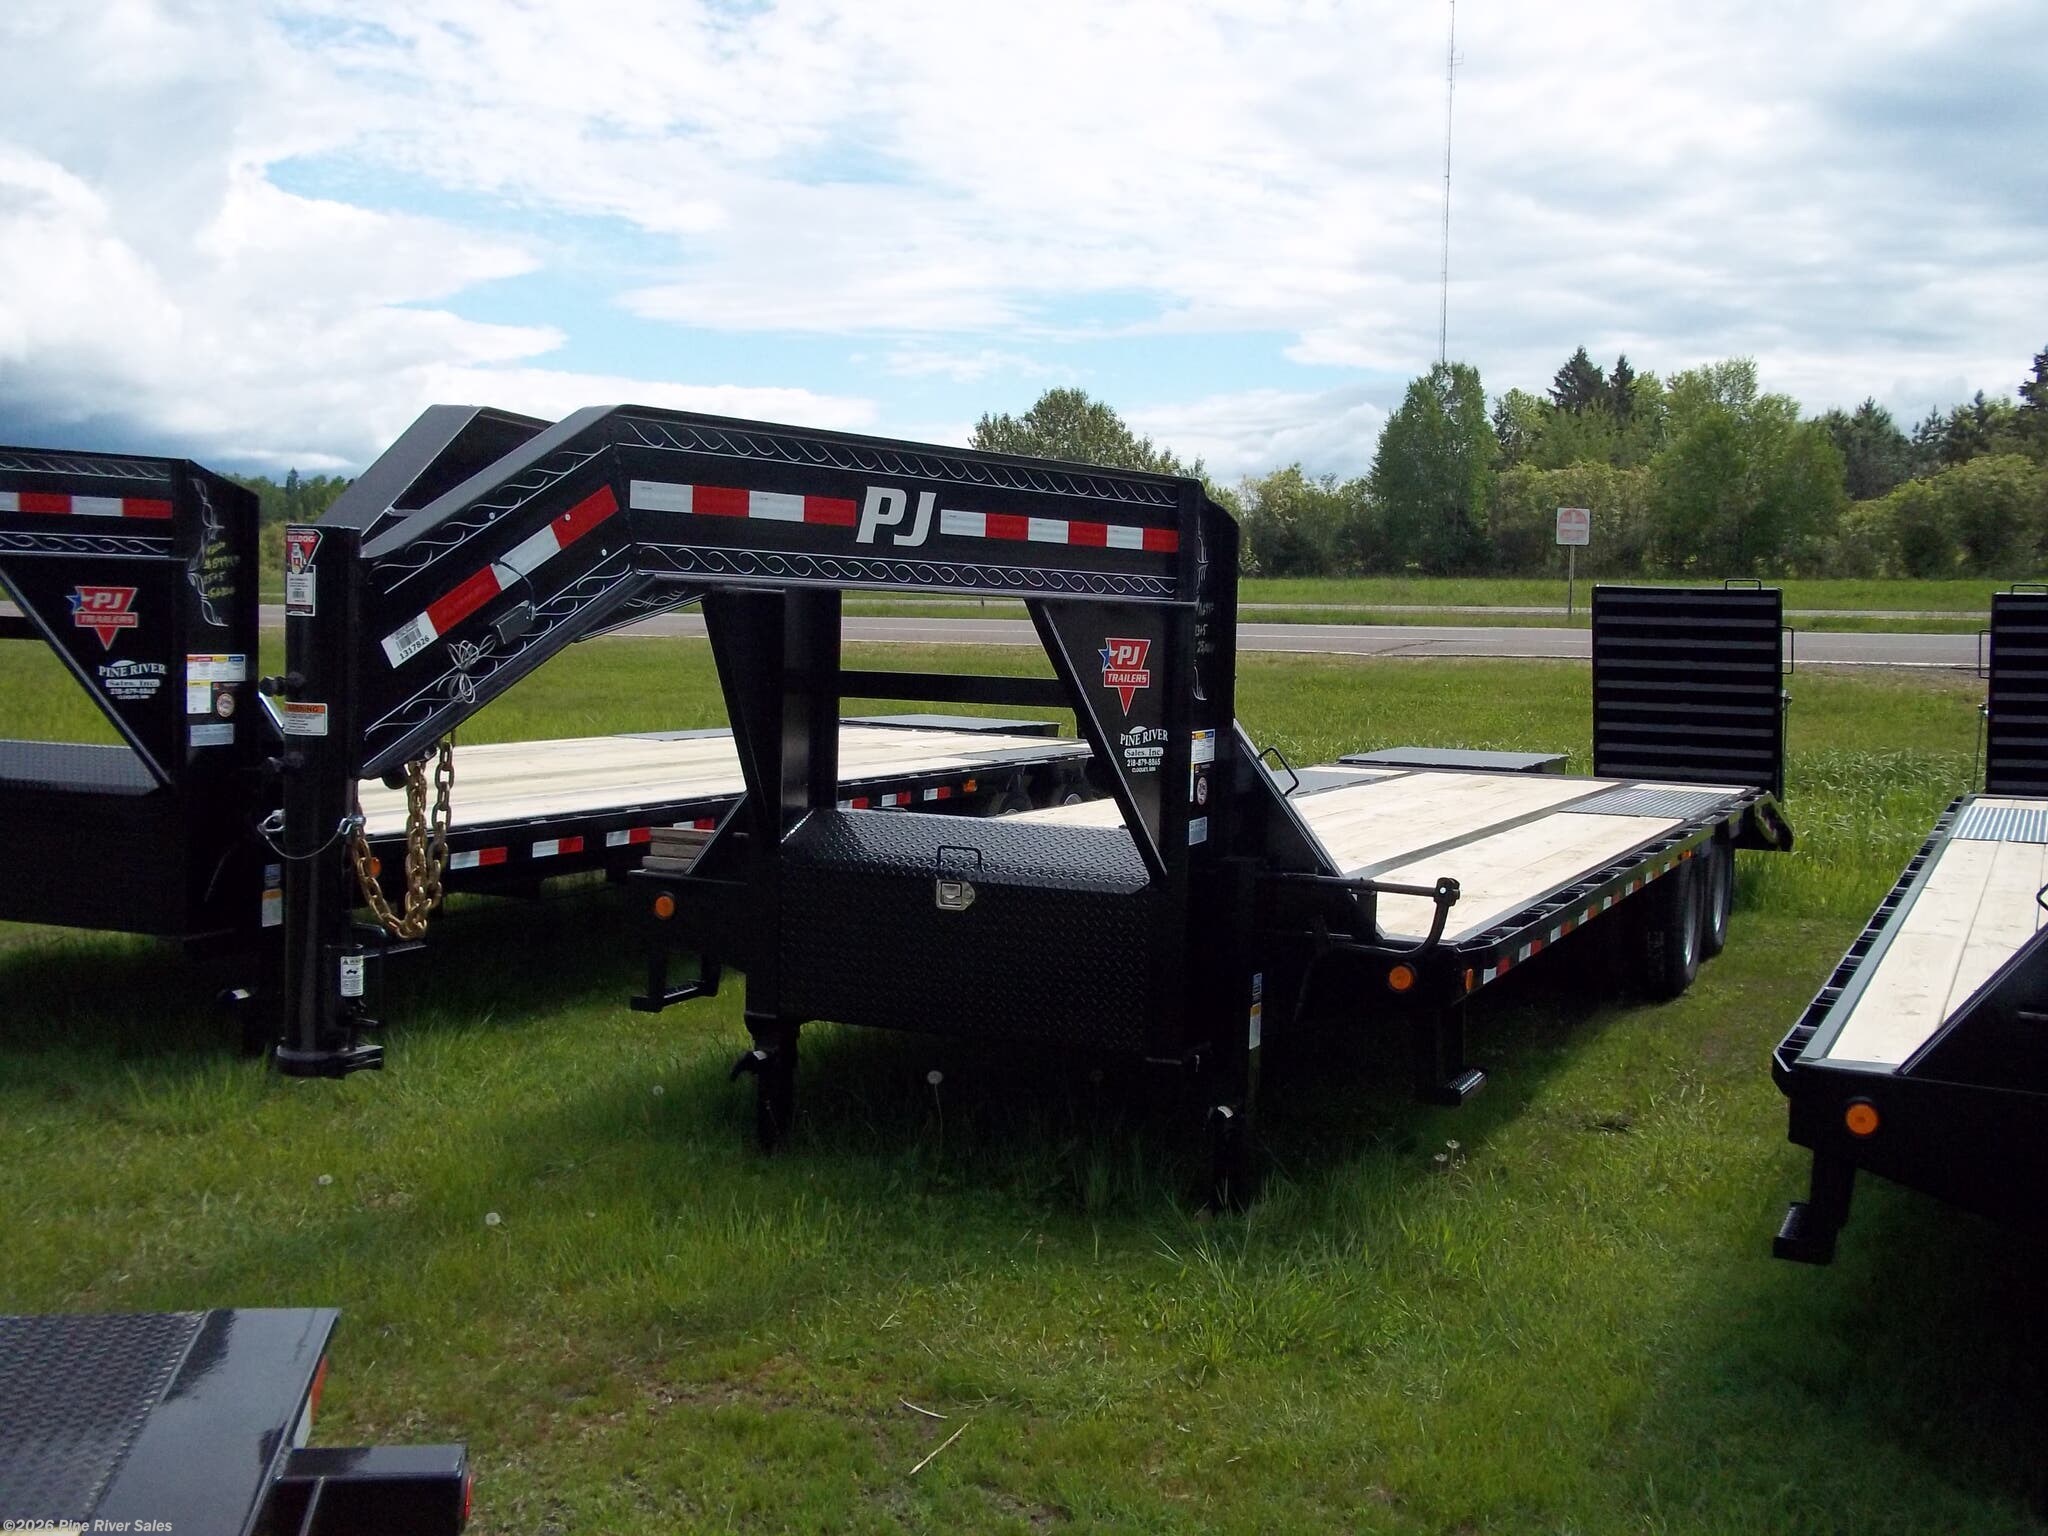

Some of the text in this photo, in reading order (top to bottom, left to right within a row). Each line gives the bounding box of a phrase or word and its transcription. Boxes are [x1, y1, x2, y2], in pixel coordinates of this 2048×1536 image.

[856, 486, 937, 547] PJ
[92, 593, 123, 609] PJ
[400, 634, 430, 660] 1317826
[1116, 645, 1140, 666] PJ
[98, 663, 167, 678] PINE RIVER
[1107, 673, 1147, 683] TRAILERS
[1120, 728, 1168, 746] PINE RIVER
